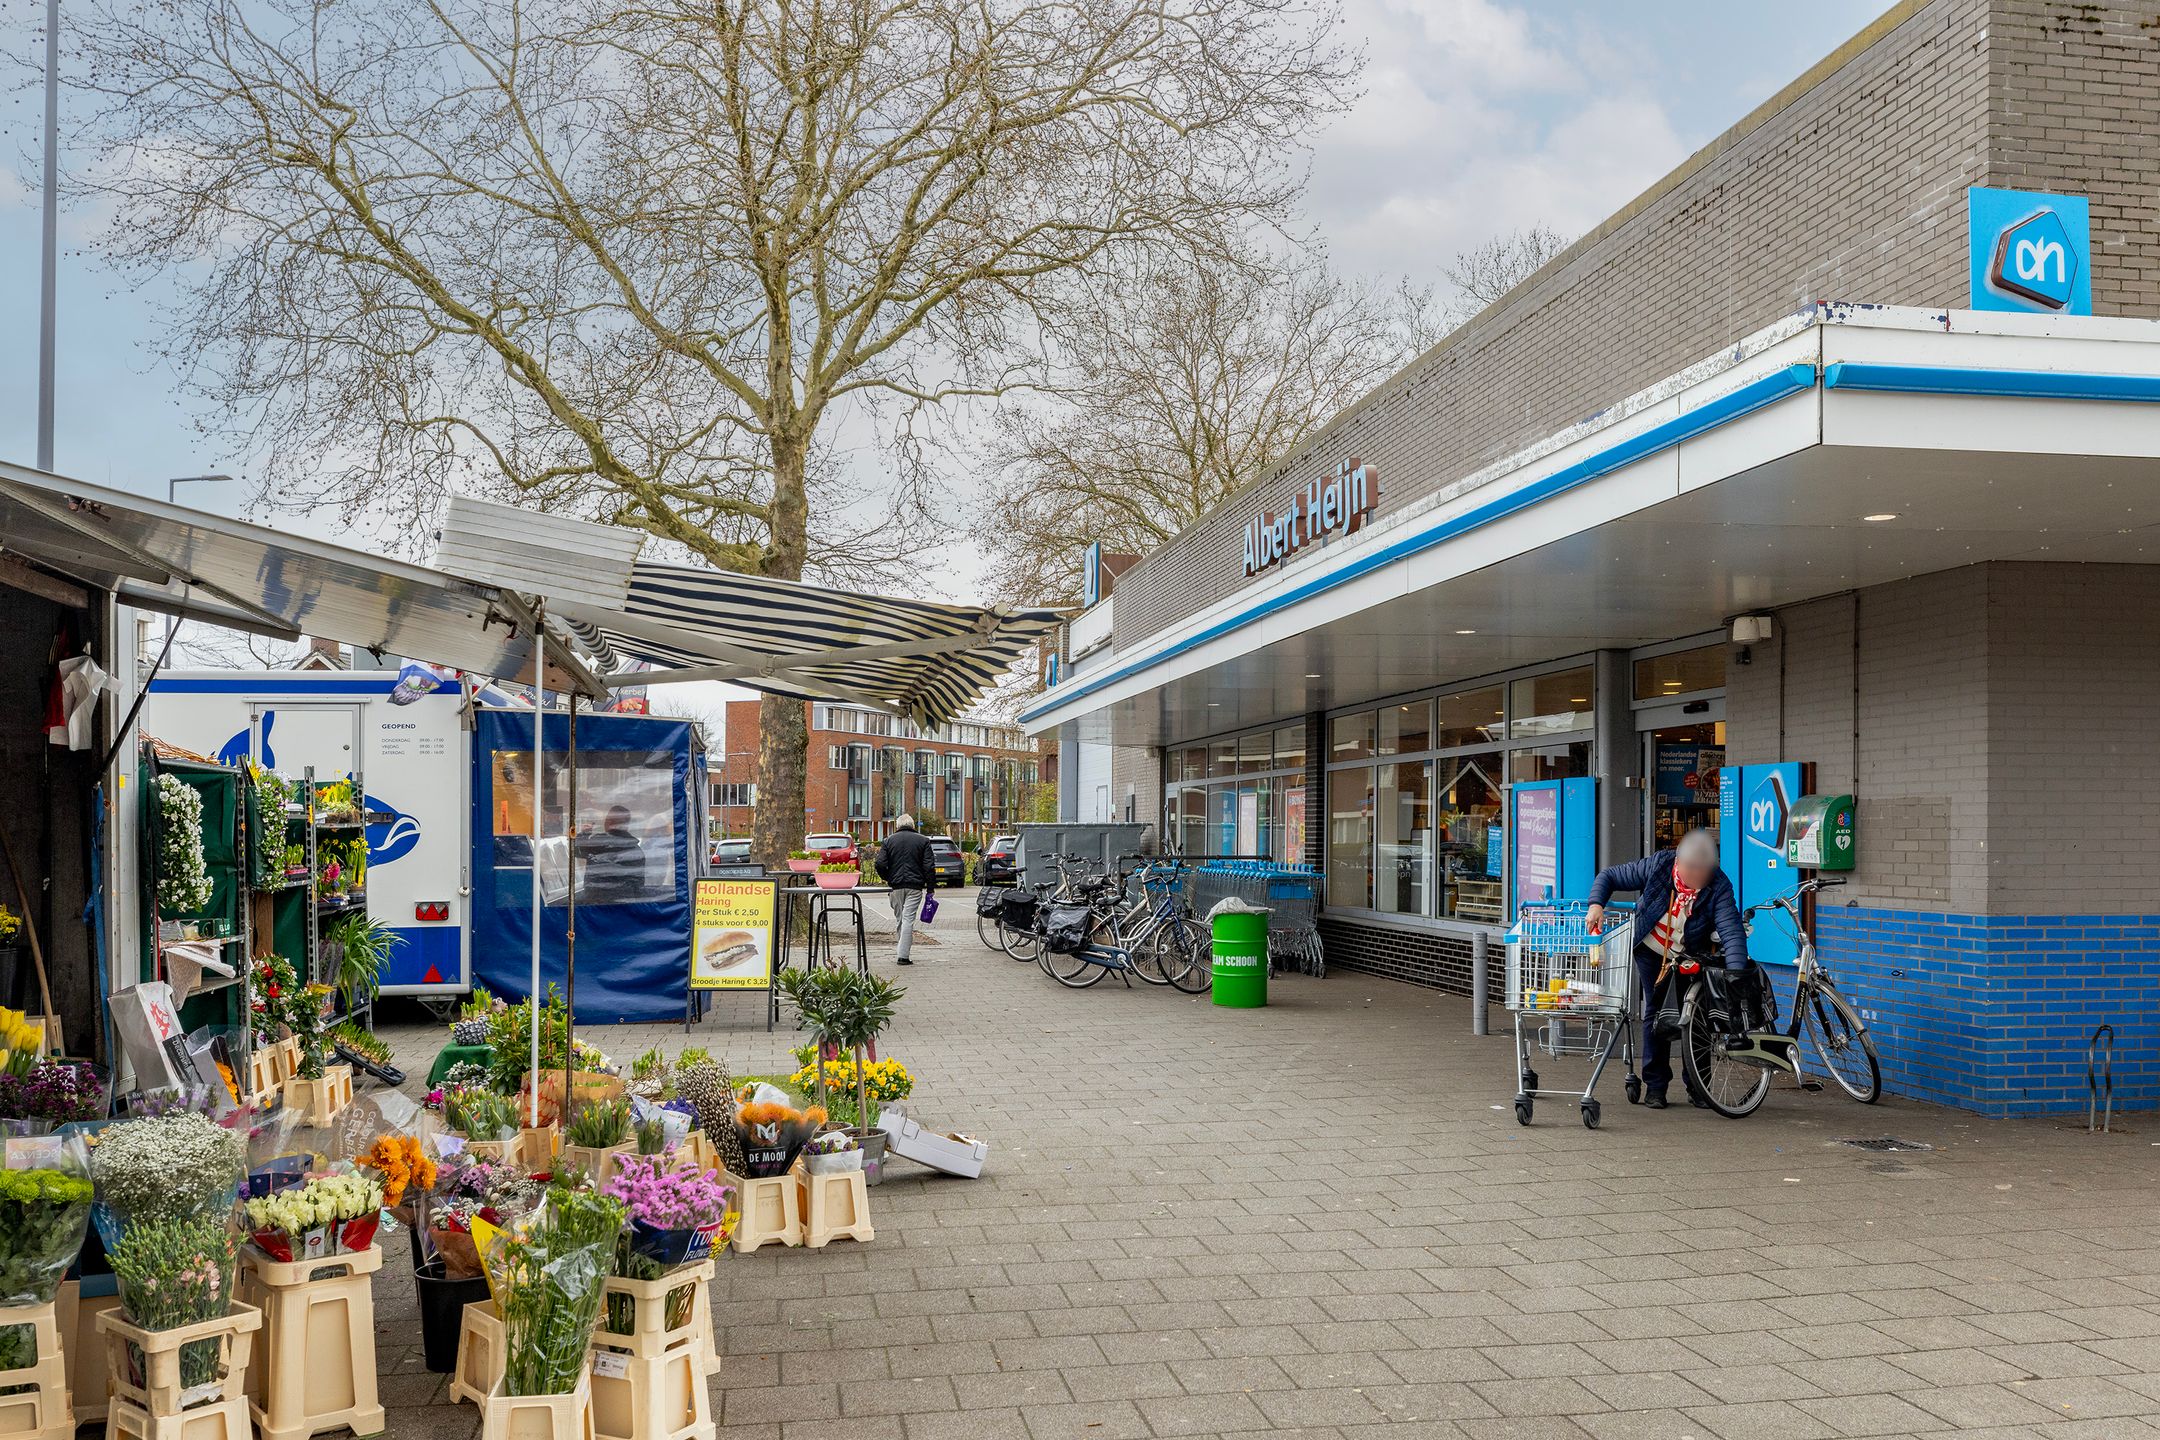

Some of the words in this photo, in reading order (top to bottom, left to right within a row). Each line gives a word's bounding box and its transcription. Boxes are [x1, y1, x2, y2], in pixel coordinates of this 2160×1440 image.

[1243, 494, 1300, 577] Albert
[1307, 457, 1367, 539] Heijn
[1520, 793, 1534, 804] Onze
[697, 883, 771, 895] Hollandse
[696, 897, 731, 908] Haring
[696, 908, 710, 916] Per
[712, 908, 732, 916] Stuk
[741, 909, 759, 917] 2,50
[752, 919, 768, 927] 9,00
[1225, 955, 1258, 967] SCHOON
[691, 978, 720, 986] Broodje
[721, 978, 745, 986] Haring
[749, 1153, 760, 1163] DE
